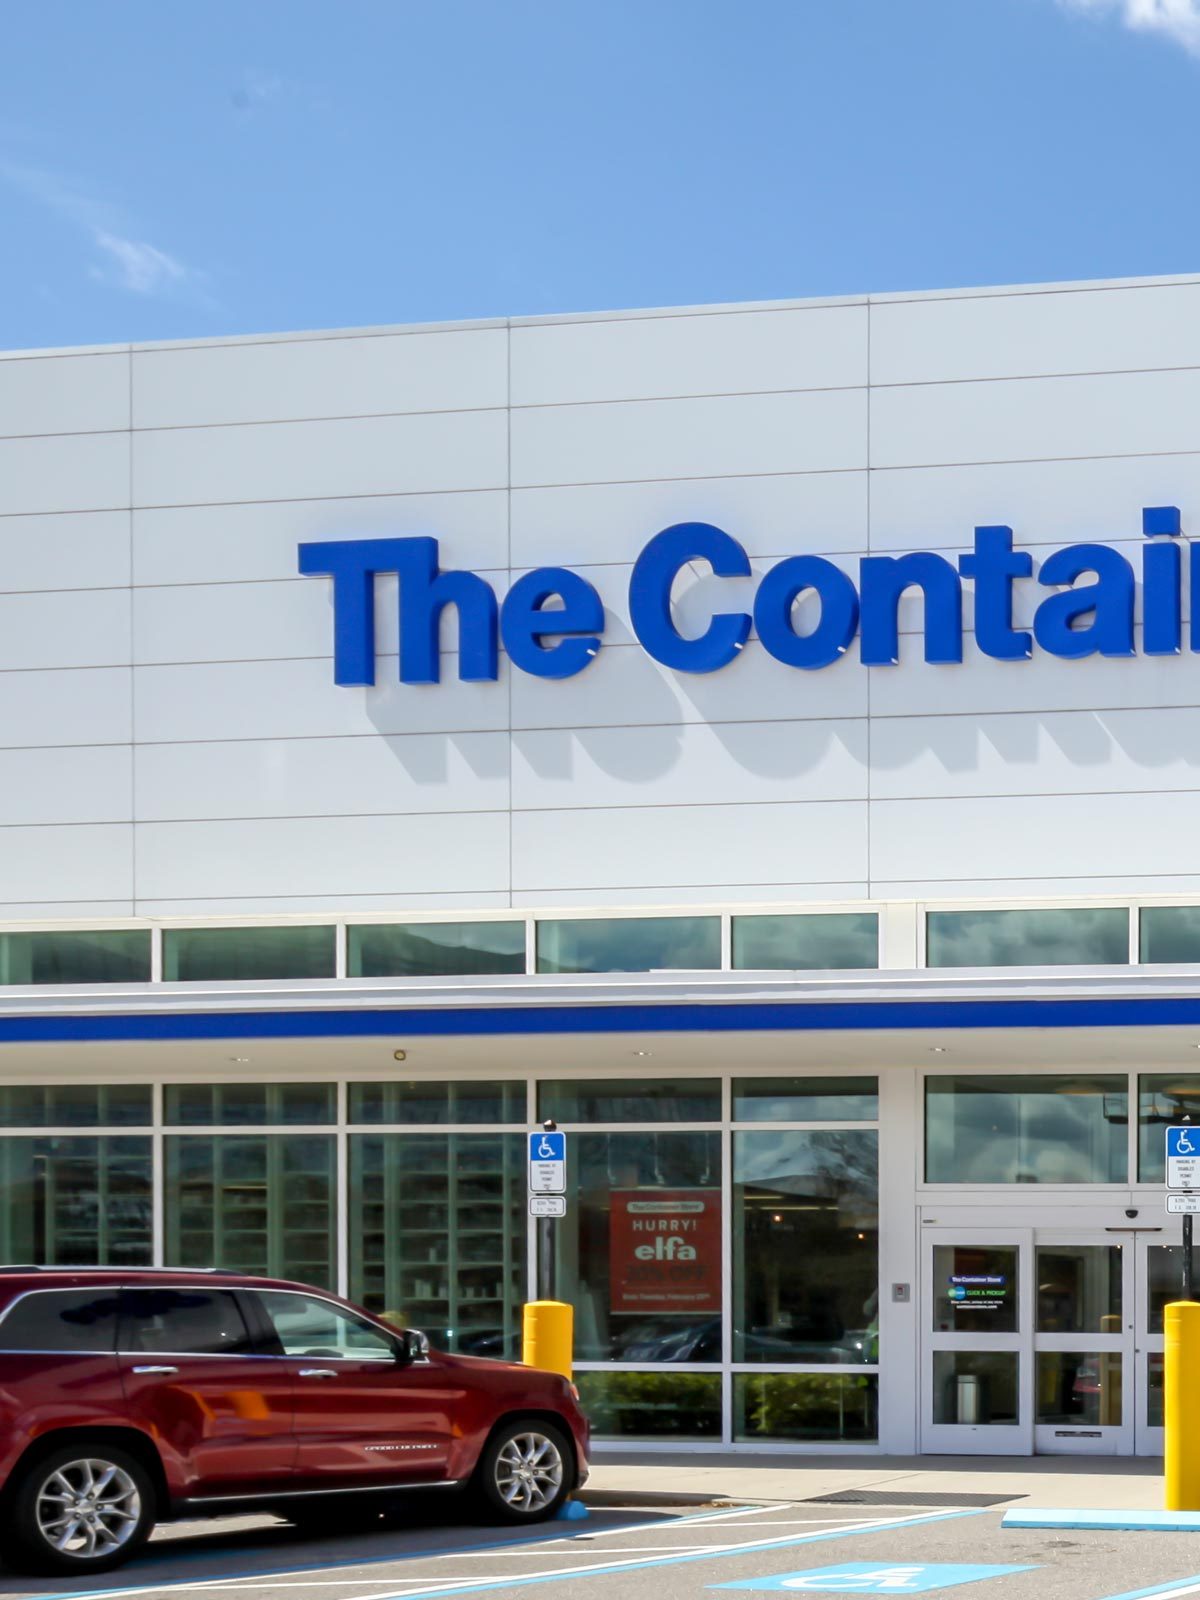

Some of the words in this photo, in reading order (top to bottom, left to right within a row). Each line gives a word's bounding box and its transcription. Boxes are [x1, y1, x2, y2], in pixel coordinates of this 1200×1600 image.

[298, 536, 605, 687] The
[632, 1219, 697, 1232] HURRY!
[634, 1236, 697, 1260] elfa
